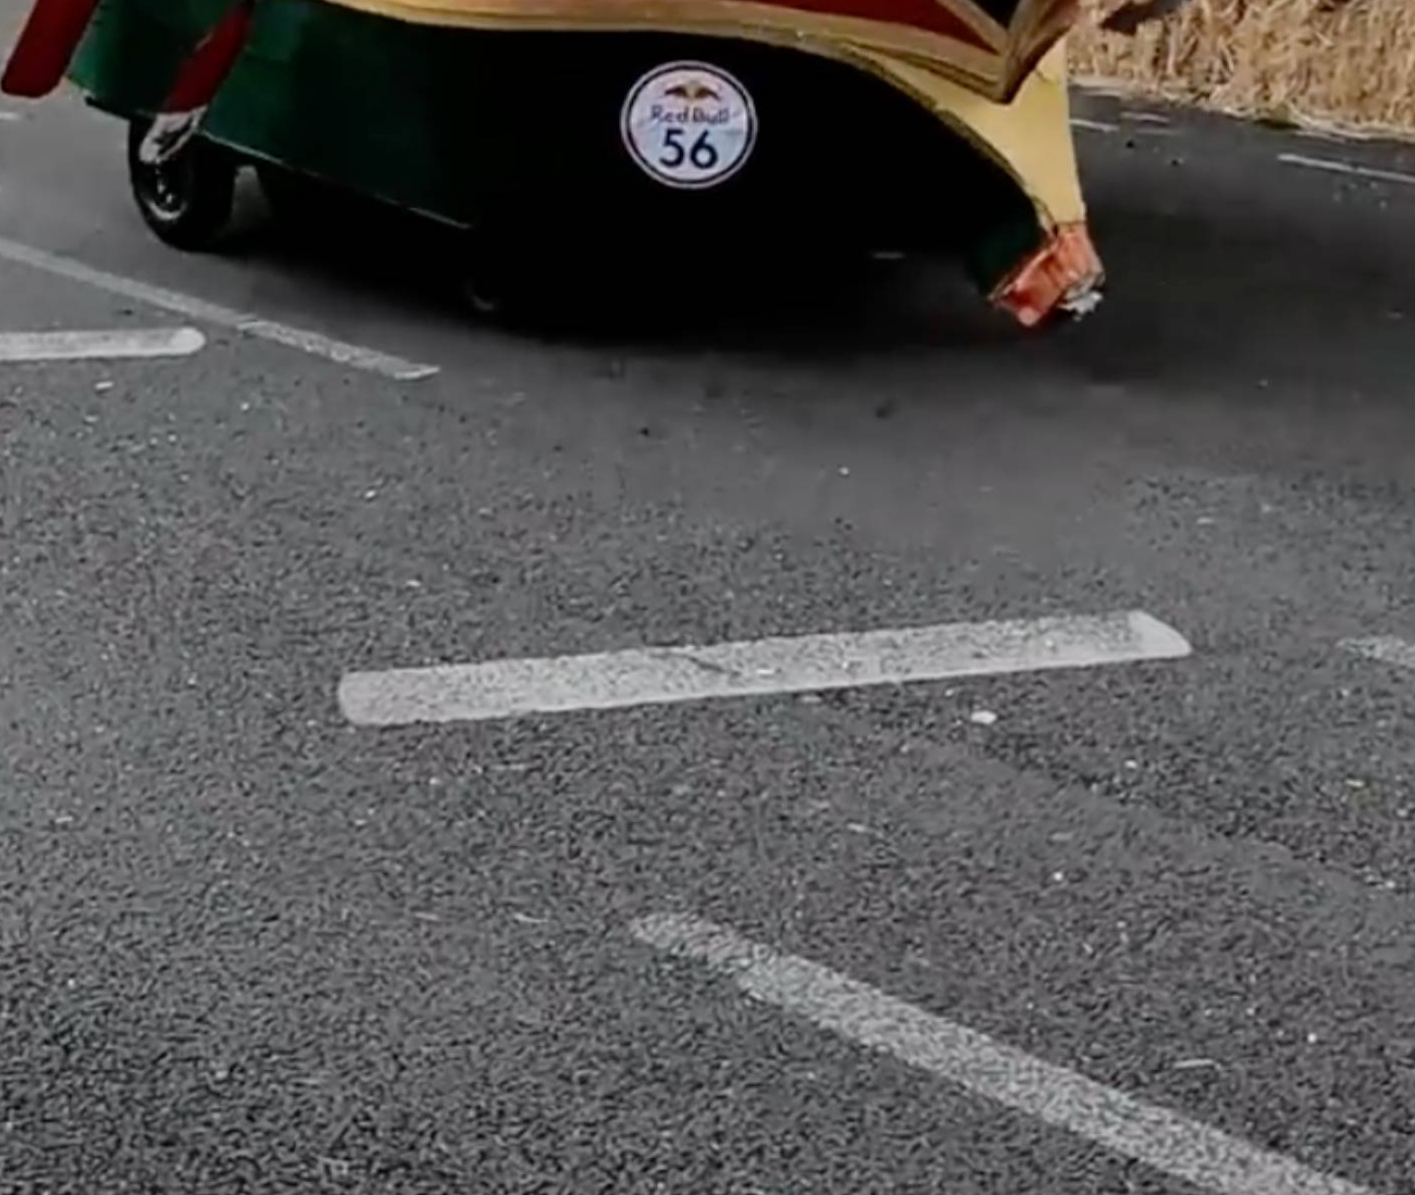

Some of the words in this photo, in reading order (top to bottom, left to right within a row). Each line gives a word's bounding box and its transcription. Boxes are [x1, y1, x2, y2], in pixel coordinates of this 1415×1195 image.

[650, 105, 689, 124] Red
[692, 106, 730, 125] Bull
[659, 128, 718, 169] 56
